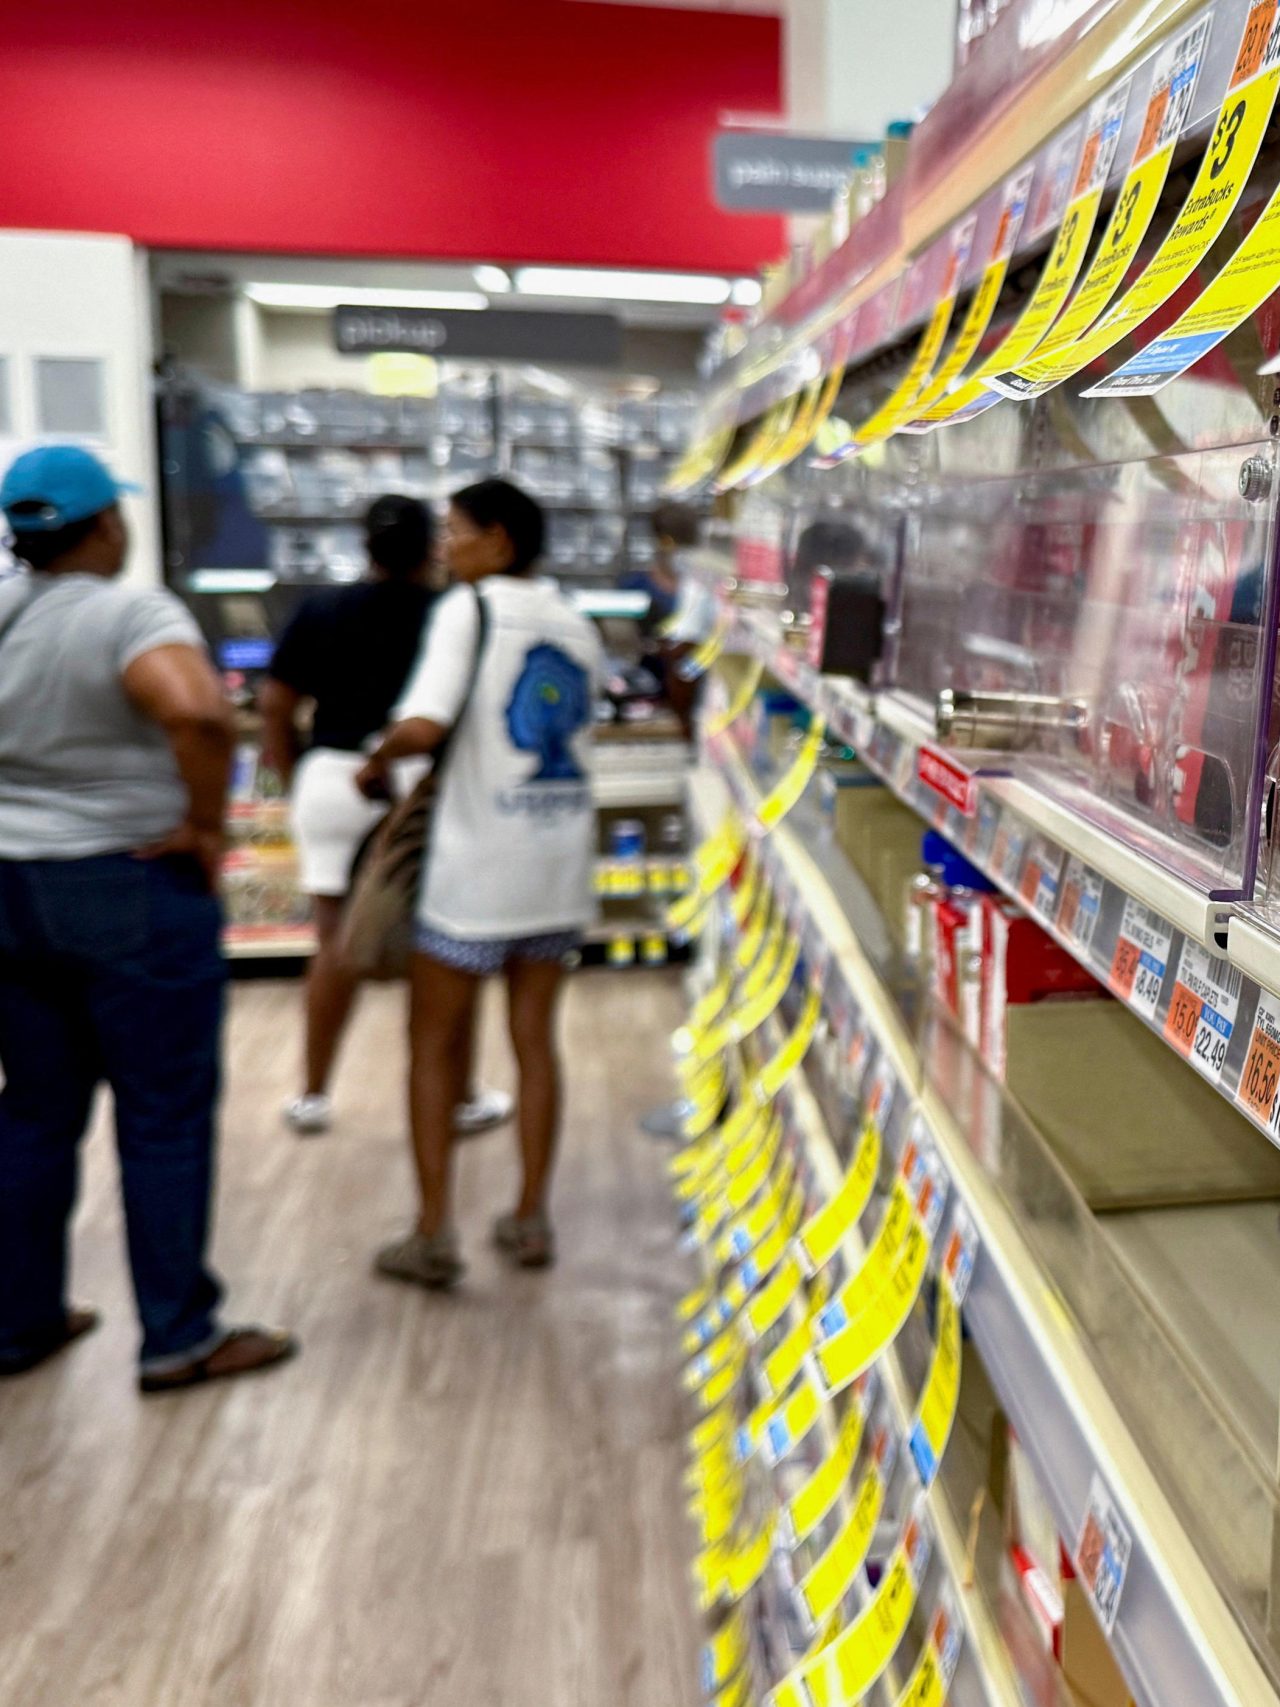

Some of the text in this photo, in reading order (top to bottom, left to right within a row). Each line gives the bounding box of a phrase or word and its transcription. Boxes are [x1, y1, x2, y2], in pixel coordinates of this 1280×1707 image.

[1210, 100, 1247, 181] $3
[1111, 180, 1142, 247] $3
[1182, 181, 1234, 219] ExtraBucks
